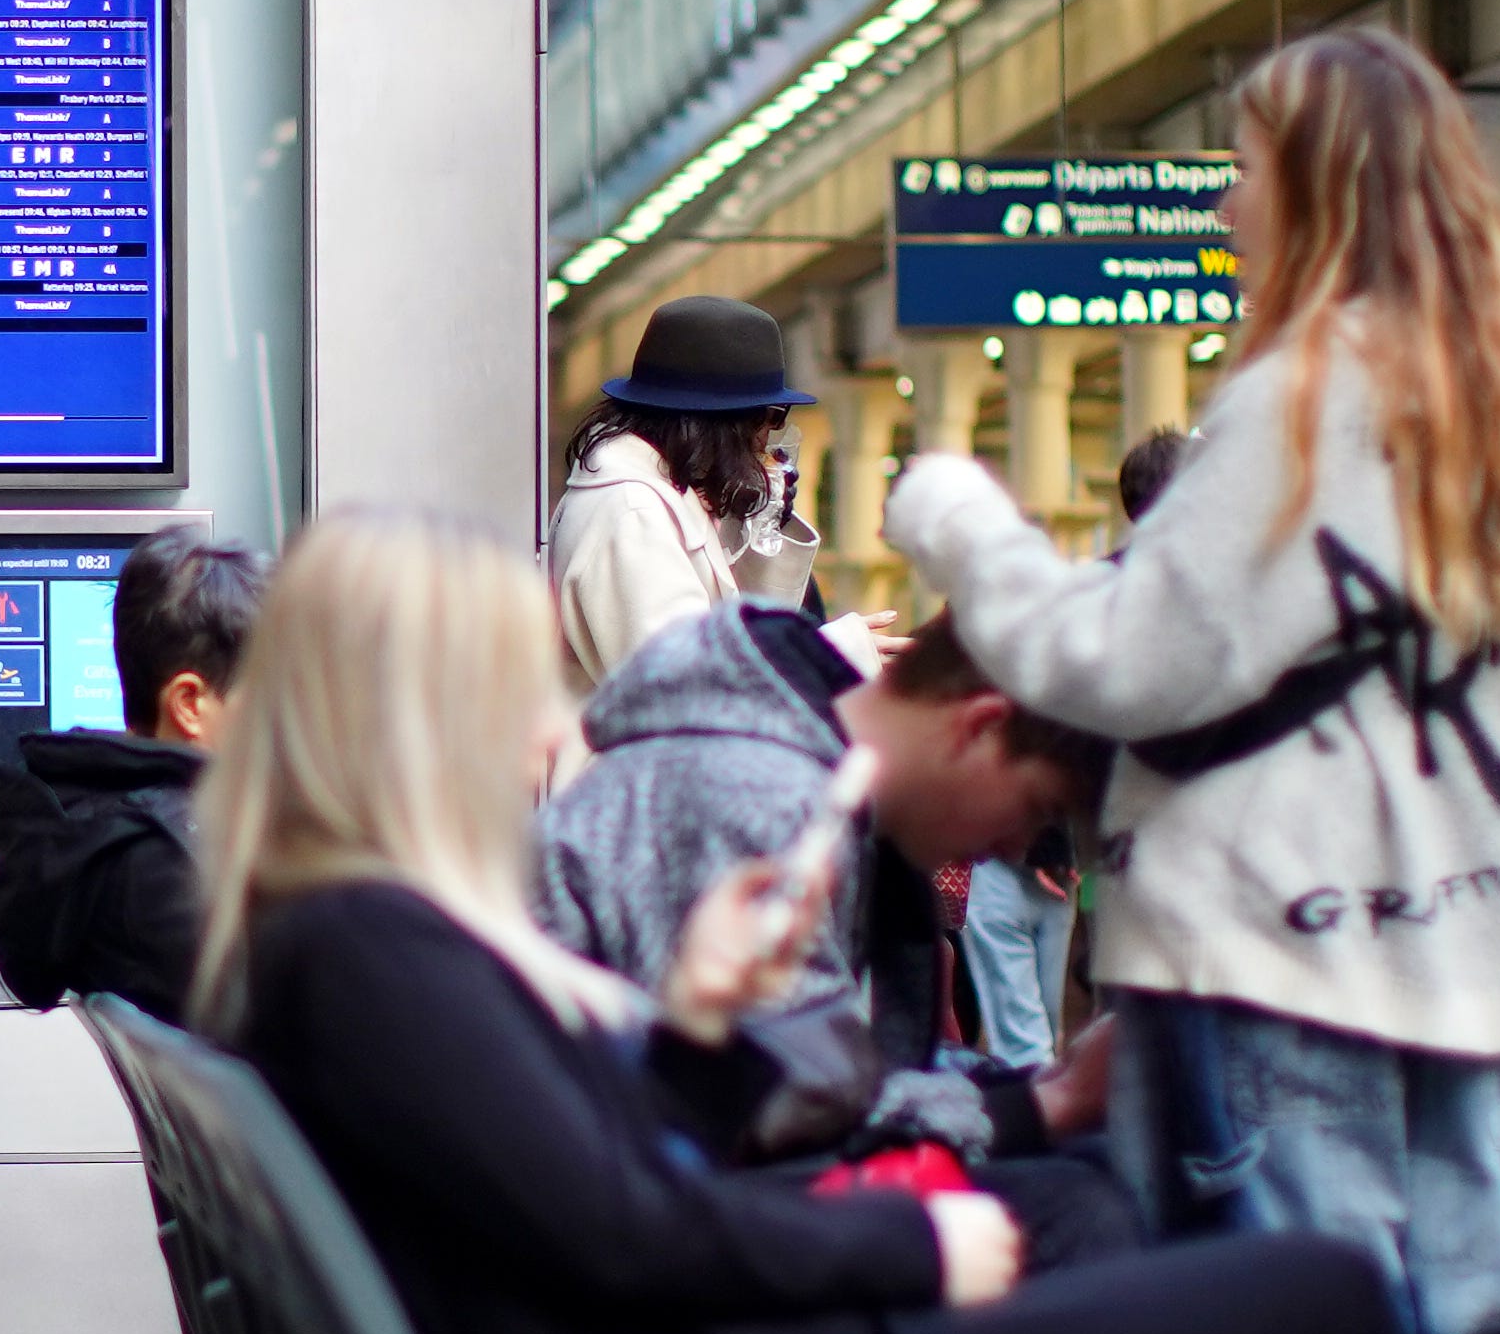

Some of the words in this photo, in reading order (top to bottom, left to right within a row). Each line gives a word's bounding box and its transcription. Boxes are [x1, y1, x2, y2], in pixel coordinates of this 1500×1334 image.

[102, 0, 111, 12] A
[102, 113, 111, 125] A
[1052, 159, 1153, 195] Départs
[103, 188, 112, 200] A
[76, 554, 111, 570] 08:21
